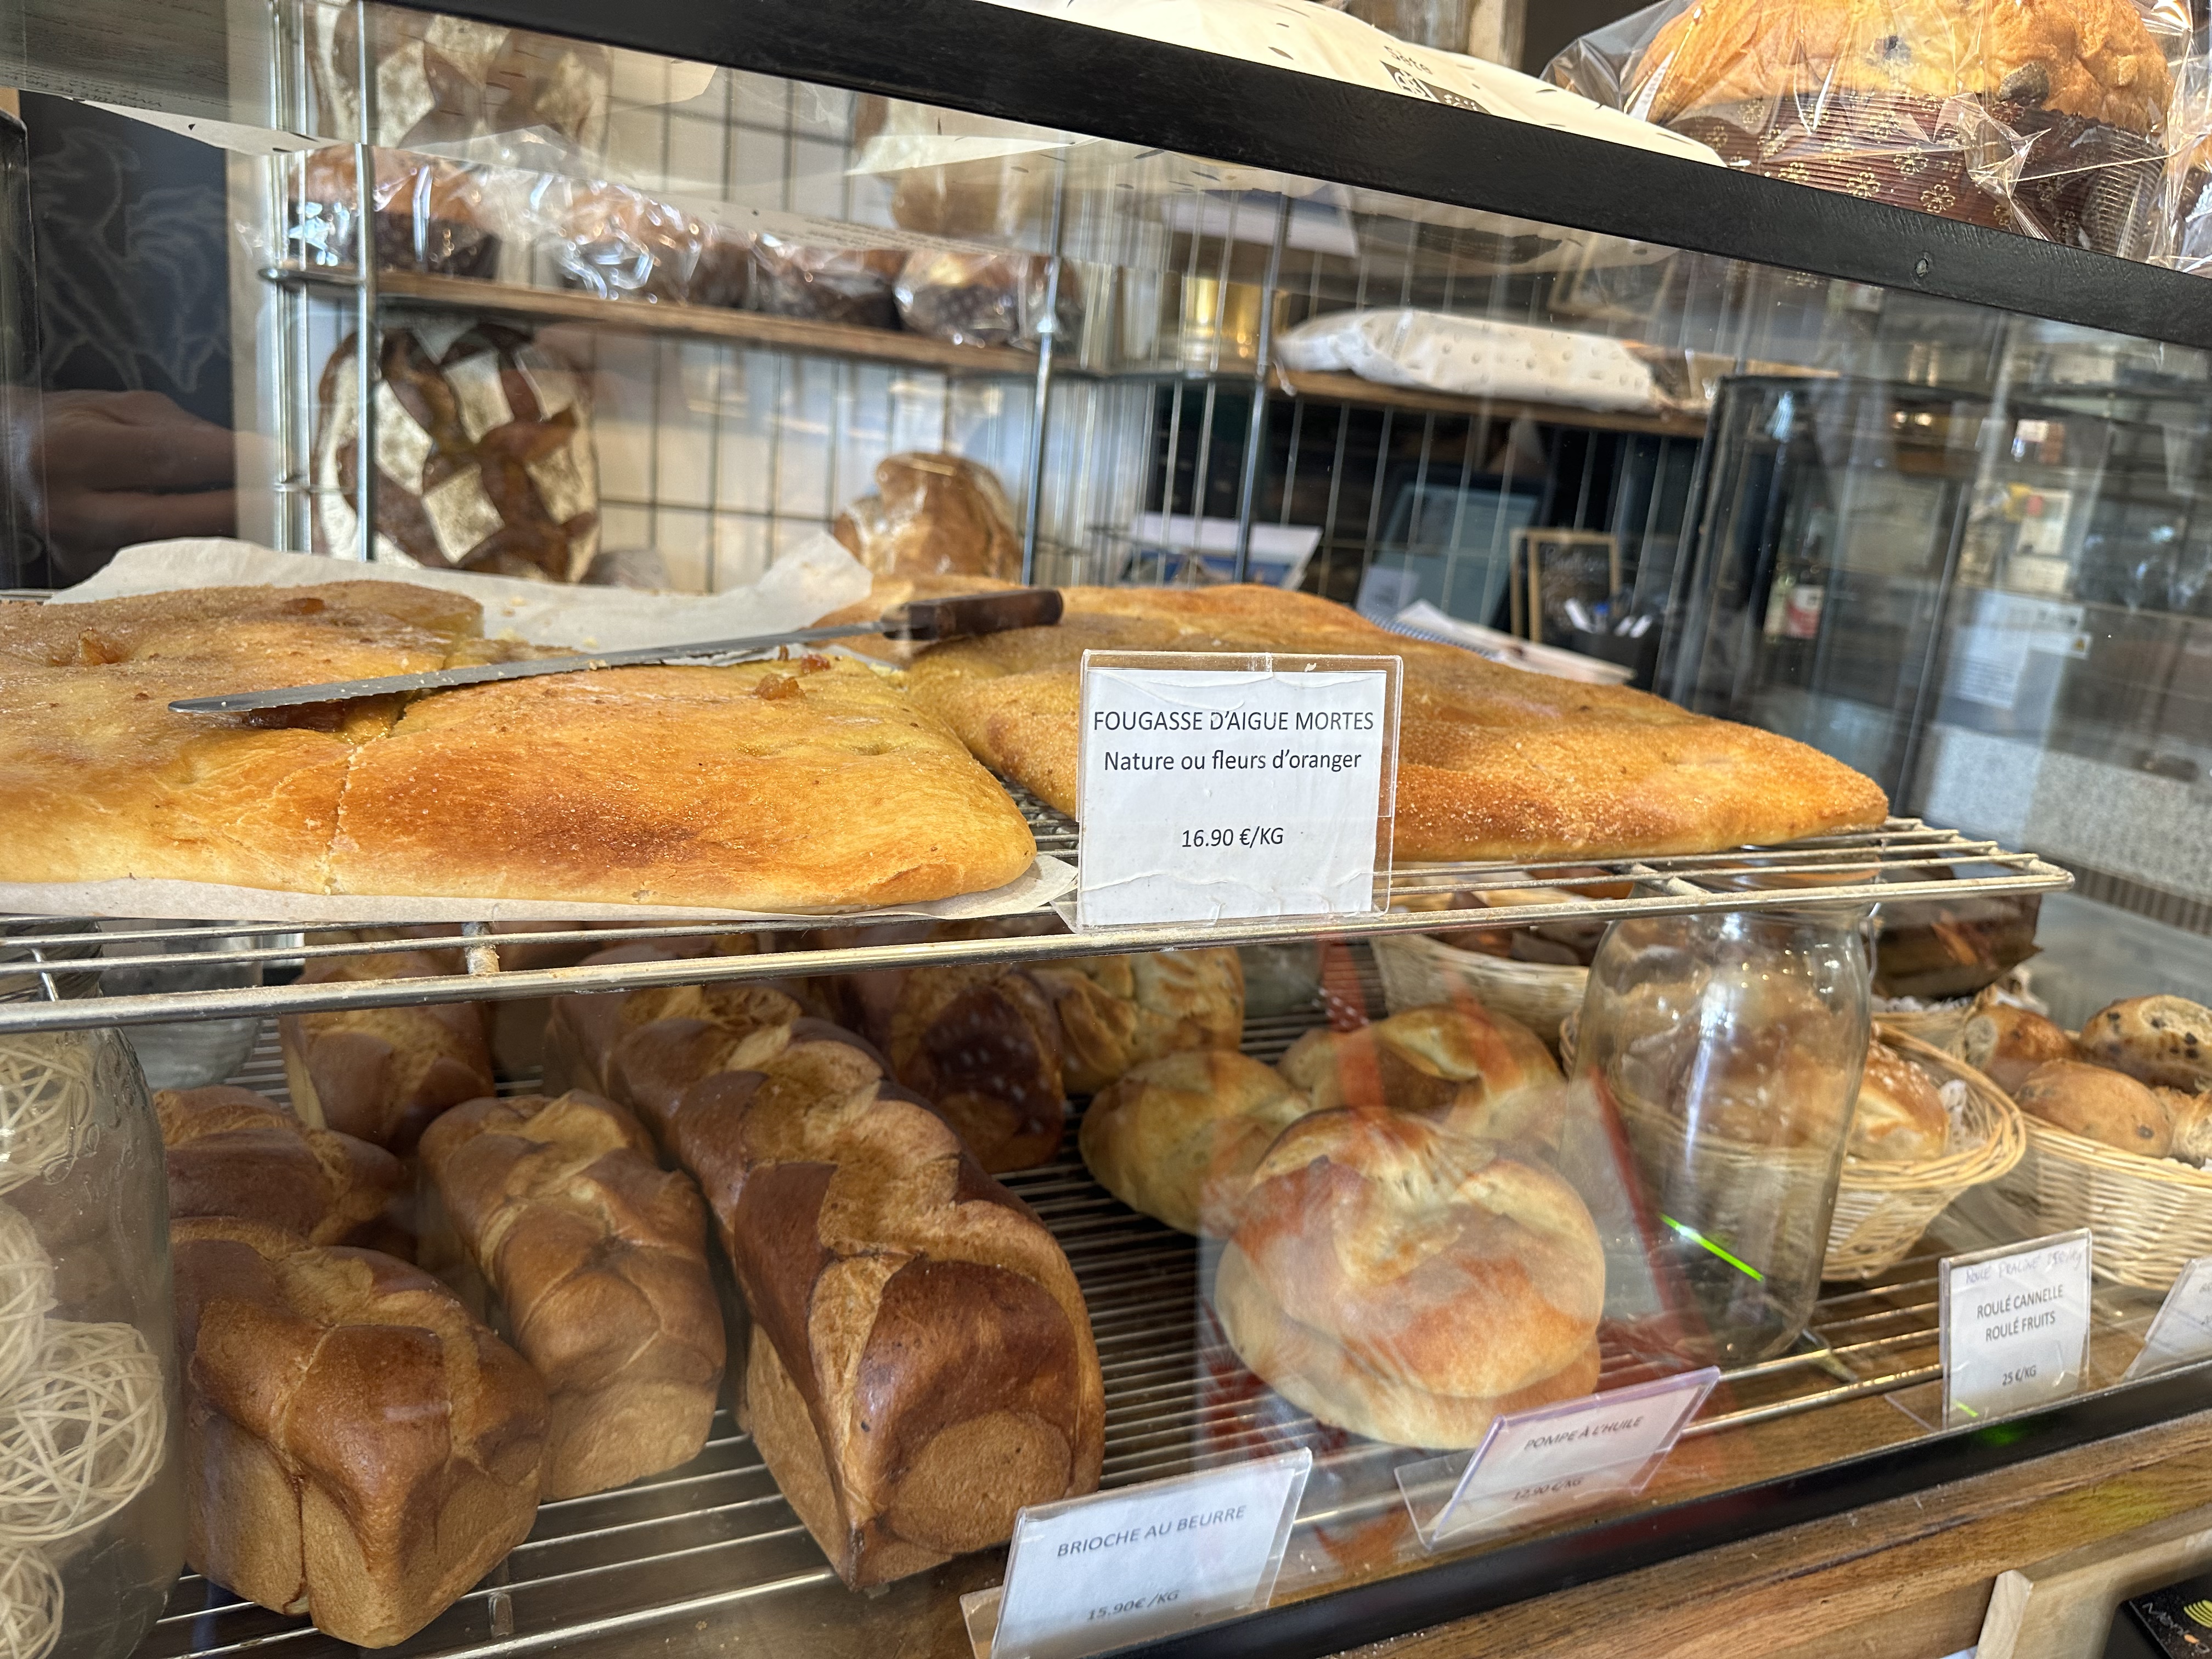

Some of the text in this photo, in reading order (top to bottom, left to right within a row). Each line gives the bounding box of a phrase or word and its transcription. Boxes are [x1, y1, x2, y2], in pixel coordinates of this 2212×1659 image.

[1093, 711, 1374, 731] FOUGASSE D’AIGUE MORTES
[1104, 749, 1361, 772] Nature ou fleurs d’oranger
[1182, 826, 1284, 849] 16.90 €/KG
[1977, 1284, 2064, 1320] ROULÉ CANNELLE
[1985, 1311, 2056, 1342] ROULÉ FRUITS
[2002, 1373, 2014, 1386] 25
[1525, 1430, 1578, 1450] POMPE
[1057, 1505, 1246, 1556] BRIOCHE AU BEURRE
